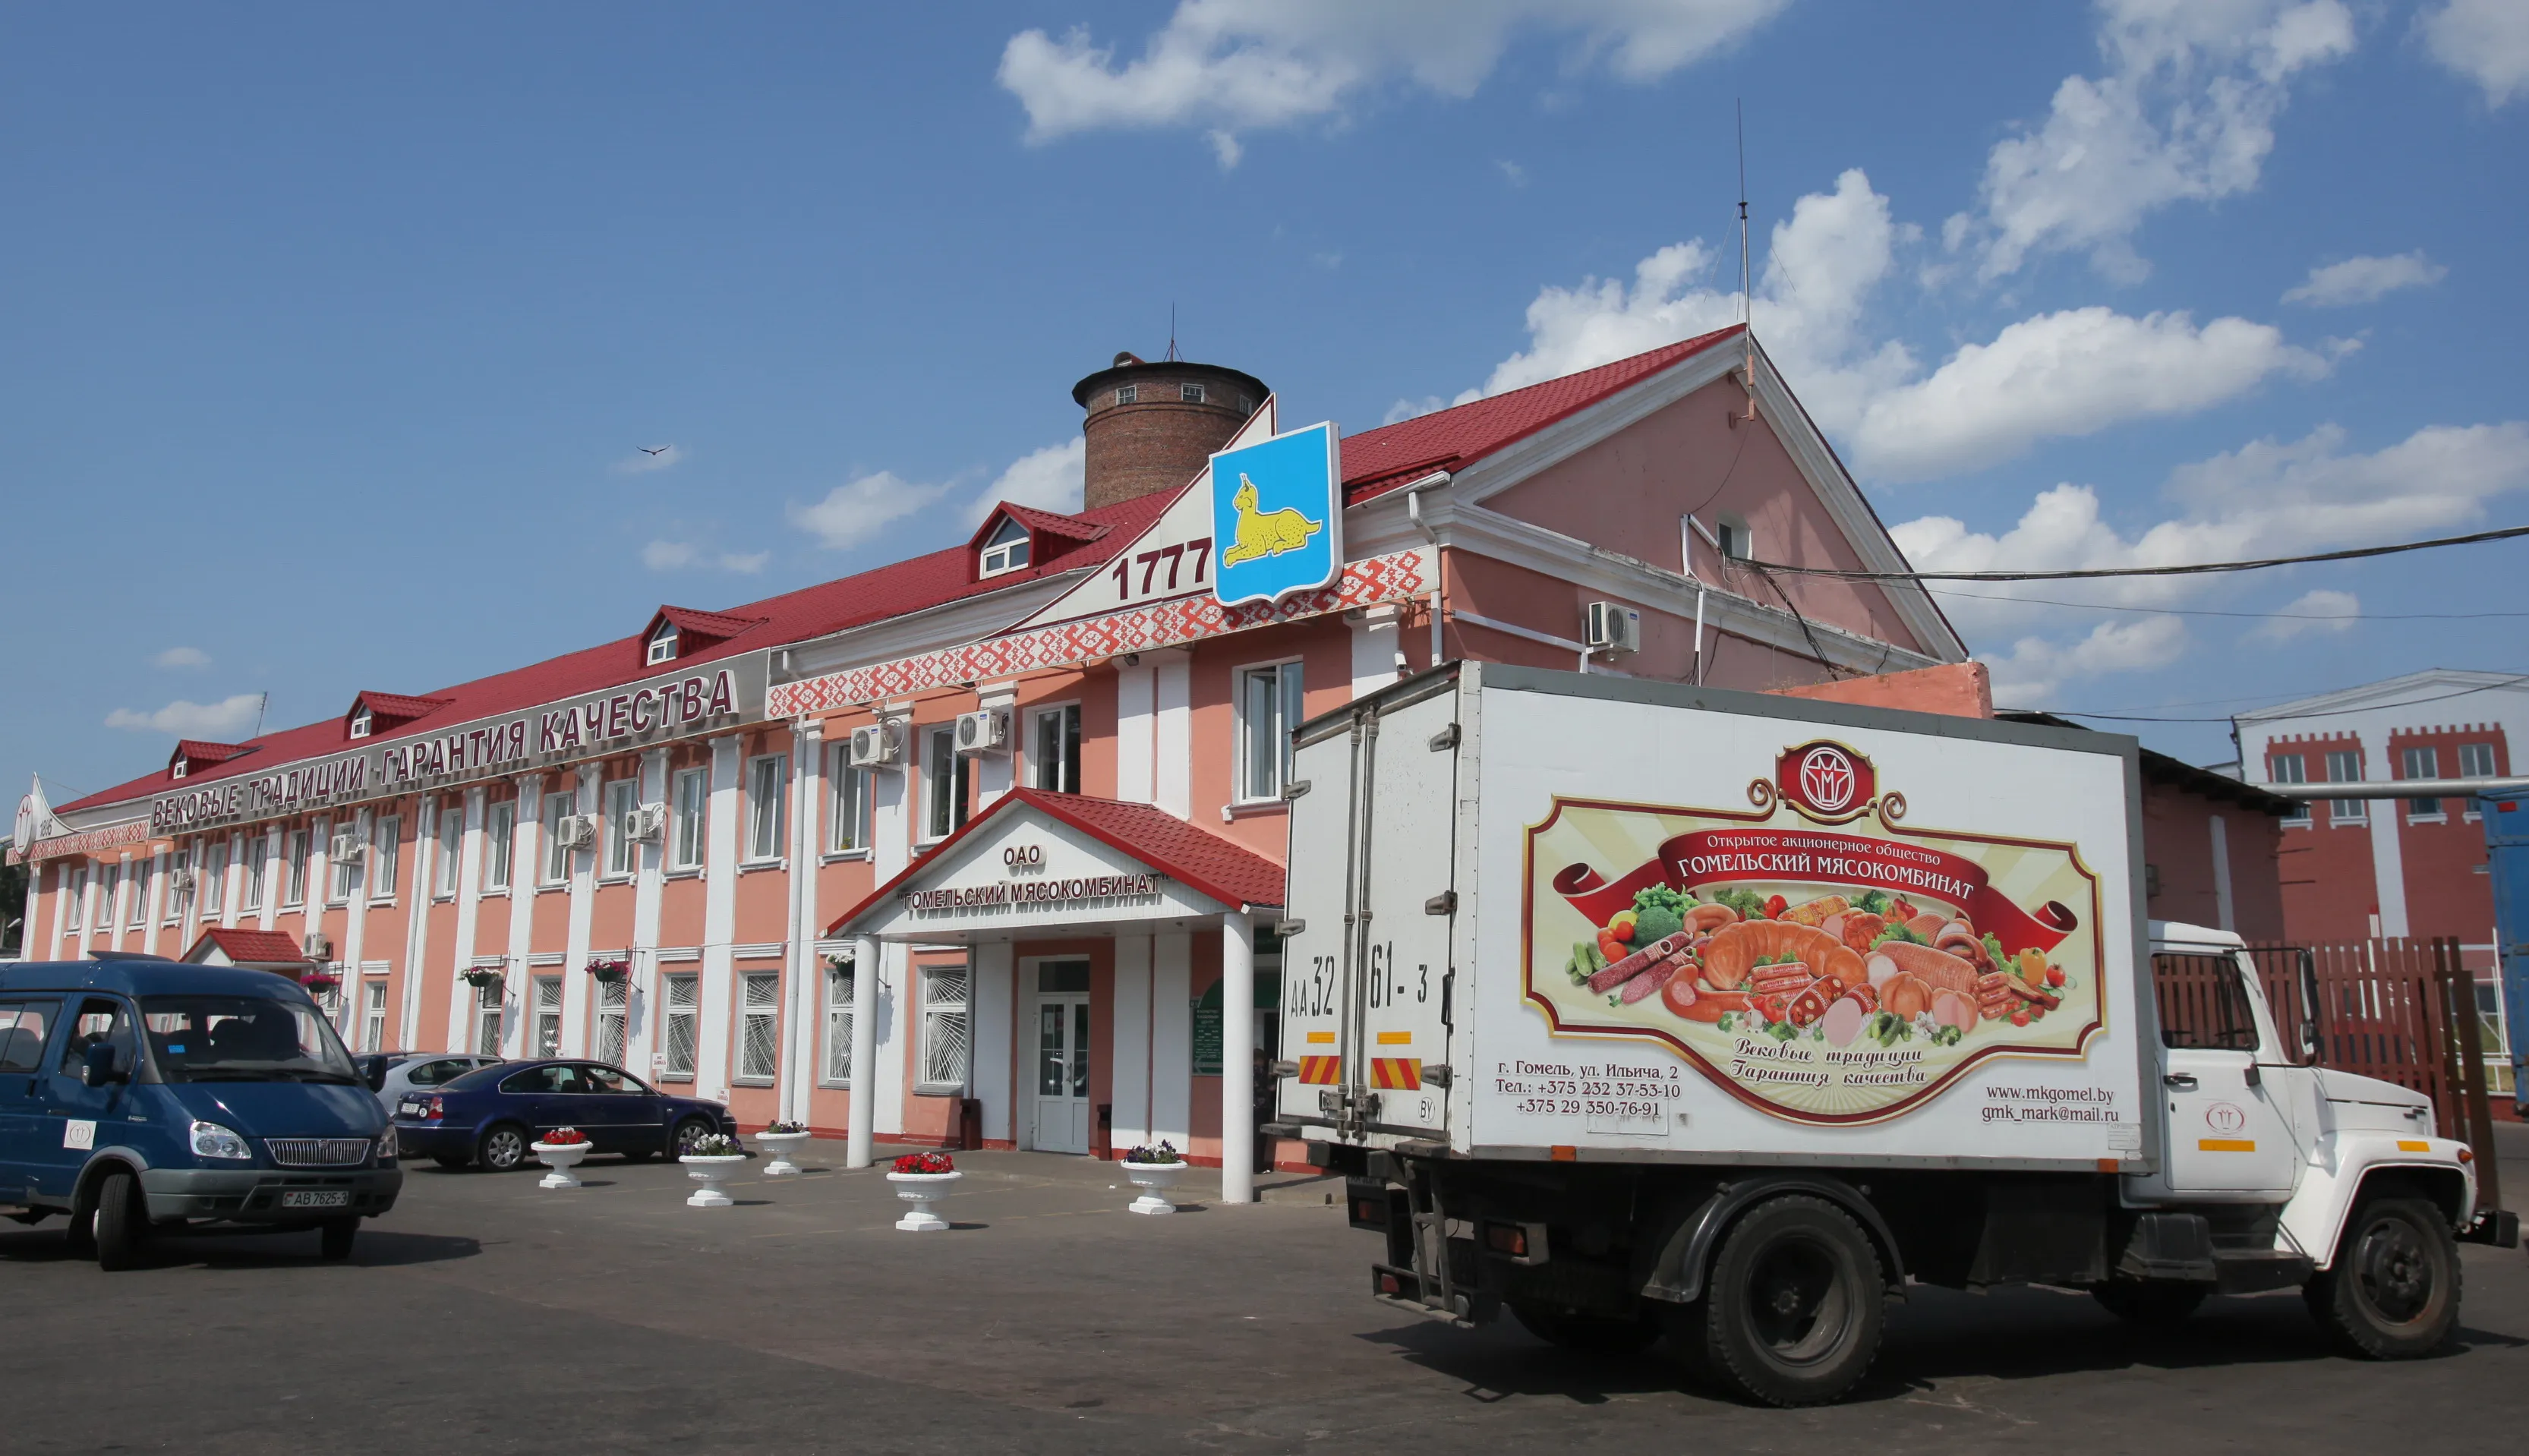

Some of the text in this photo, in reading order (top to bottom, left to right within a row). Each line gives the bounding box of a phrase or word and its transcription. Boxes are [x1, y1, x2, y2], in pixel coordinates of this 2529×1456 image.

[1112, 537, 1212, 600] 1777
[153, 669, 734, 828] ВЕКОВЫЕ ТРАДИЦИИ ГАРАНТИЯ КАЧЕСТВА
[1004, 845, 1040, 866] ОАО
[1707, 834, 1941, 866] Открытое акционерное общество
[1677, 852, 1975, 900] ГОМЕЛЬСКИЙ МЯСОКОМБИНАТ
[897, 874, 1168, 911] "ГОМЕЛЬСКИЙ МЯСОКОМБИНАТ"
[1734, 1037, 1923, 1069] Вековые традиции
[1498, 1060, 1679, 1080] г. Гомель, ул. Ильича, 2
[1729, 1059, 1926, 1088] Гарантия качества
[1495, 1078, 1681, 1098] Тел.: +375 232 37-53-10
[1986, 1086, 2114, 1105] www.mkgomel.by
[1421, 1100, 1433, 1120] BY
[1516, 1098, 1660, 1116] +375 29 350-76-91
[1982, 1105, 2119, 1122] gmk_mark@mail.ru
[294, 1192, 347, 1205] AB 7625-3
